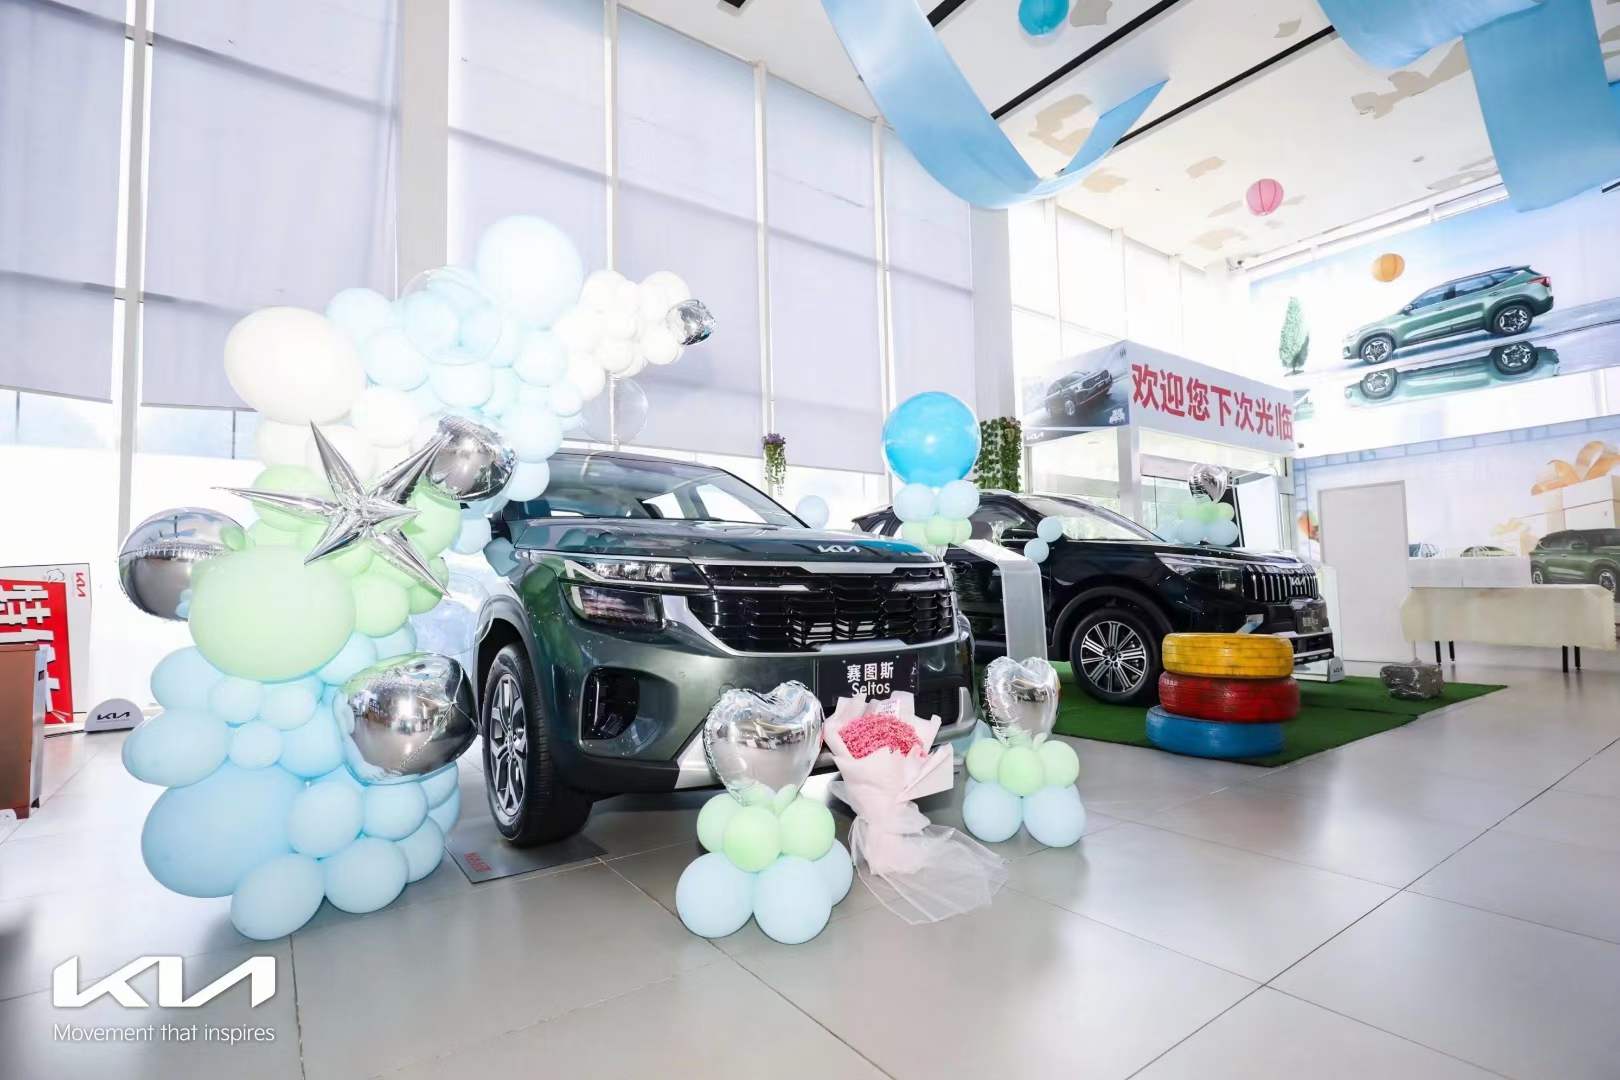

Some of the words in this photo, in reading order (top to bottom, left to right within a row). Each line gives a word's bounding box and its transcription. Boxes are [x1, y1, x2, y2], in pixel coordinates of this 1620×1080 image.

[1131, 363, 1293, 442] 欢迎您下次光临
[817, 544, 860, 553] KIA
[76, 572, 87, 598] KIA
[847, 661, 894, 683] 赛图斯
[851, 681, 890, 697] Seltos
[97, 711, 130, 720] KIA
